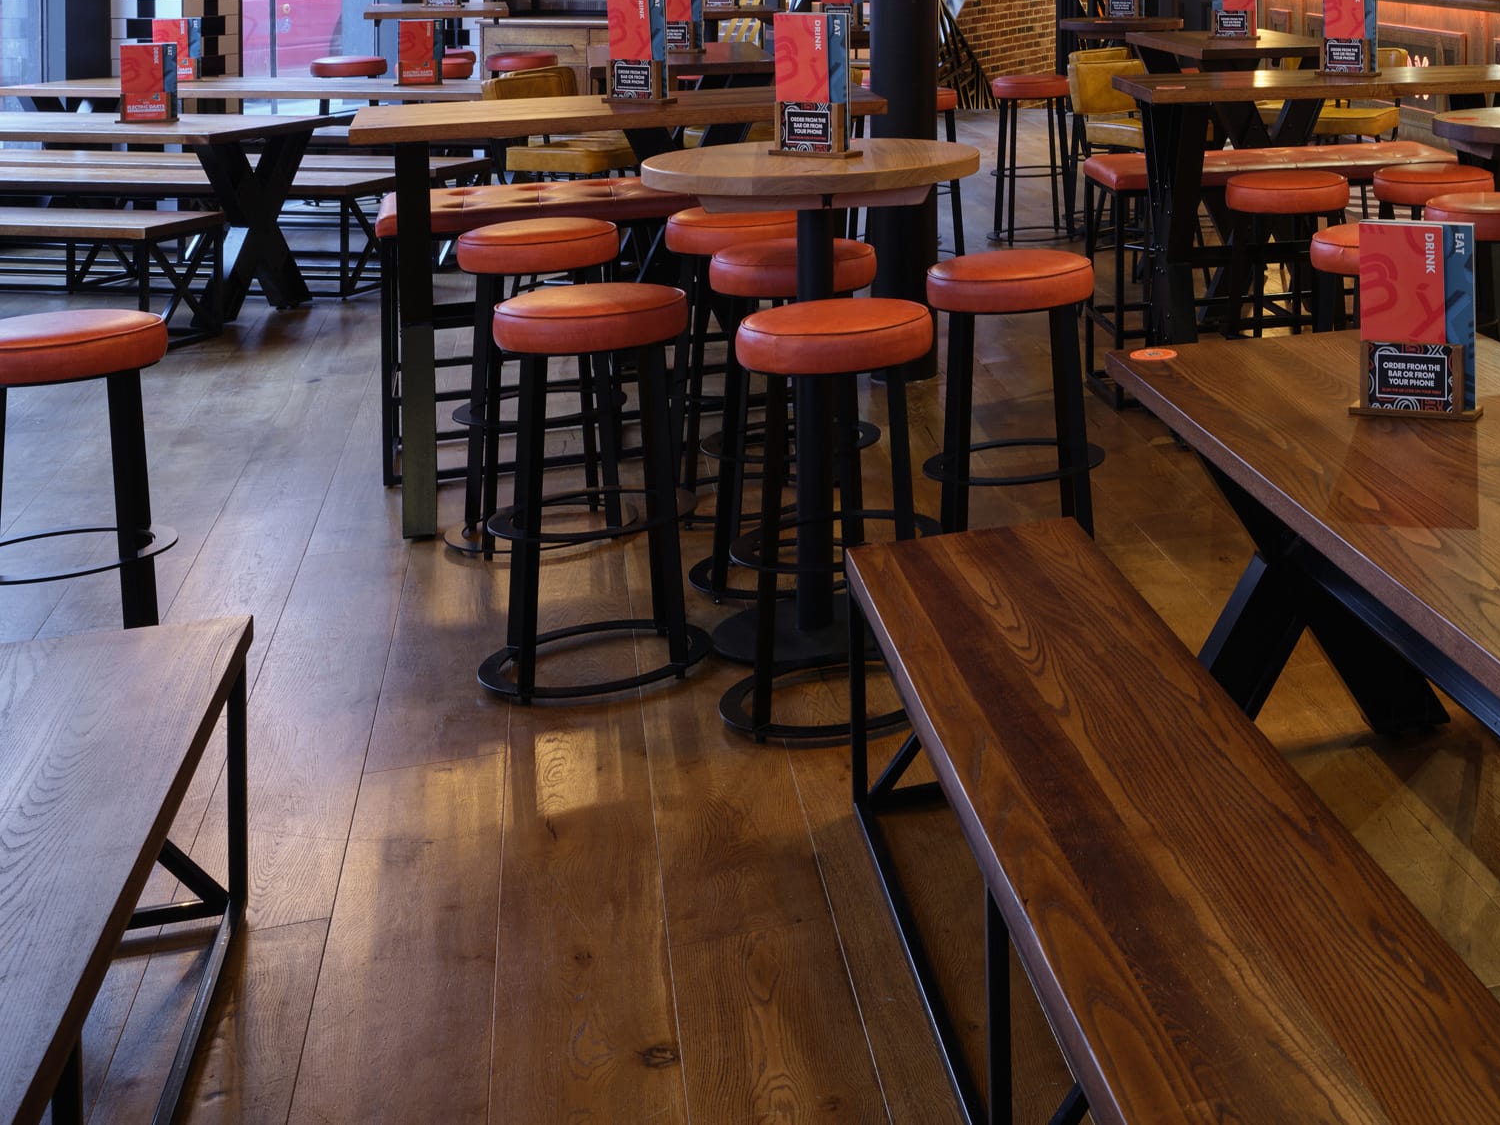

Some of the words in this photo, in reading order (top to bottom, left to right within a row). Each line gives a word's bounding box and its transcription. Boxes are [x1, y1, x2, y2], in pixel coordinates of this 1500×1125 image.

[814, 19, 822, 51] DRINK
[1424, 233, 1436, 274] DRINK
[1454, 232, 1465, 255] EAT
[1382, 361, 1406, 369] ORDER
[1406, 363, 1427, 371] FROM
[1409, 379, 1435, 387] PHONE
